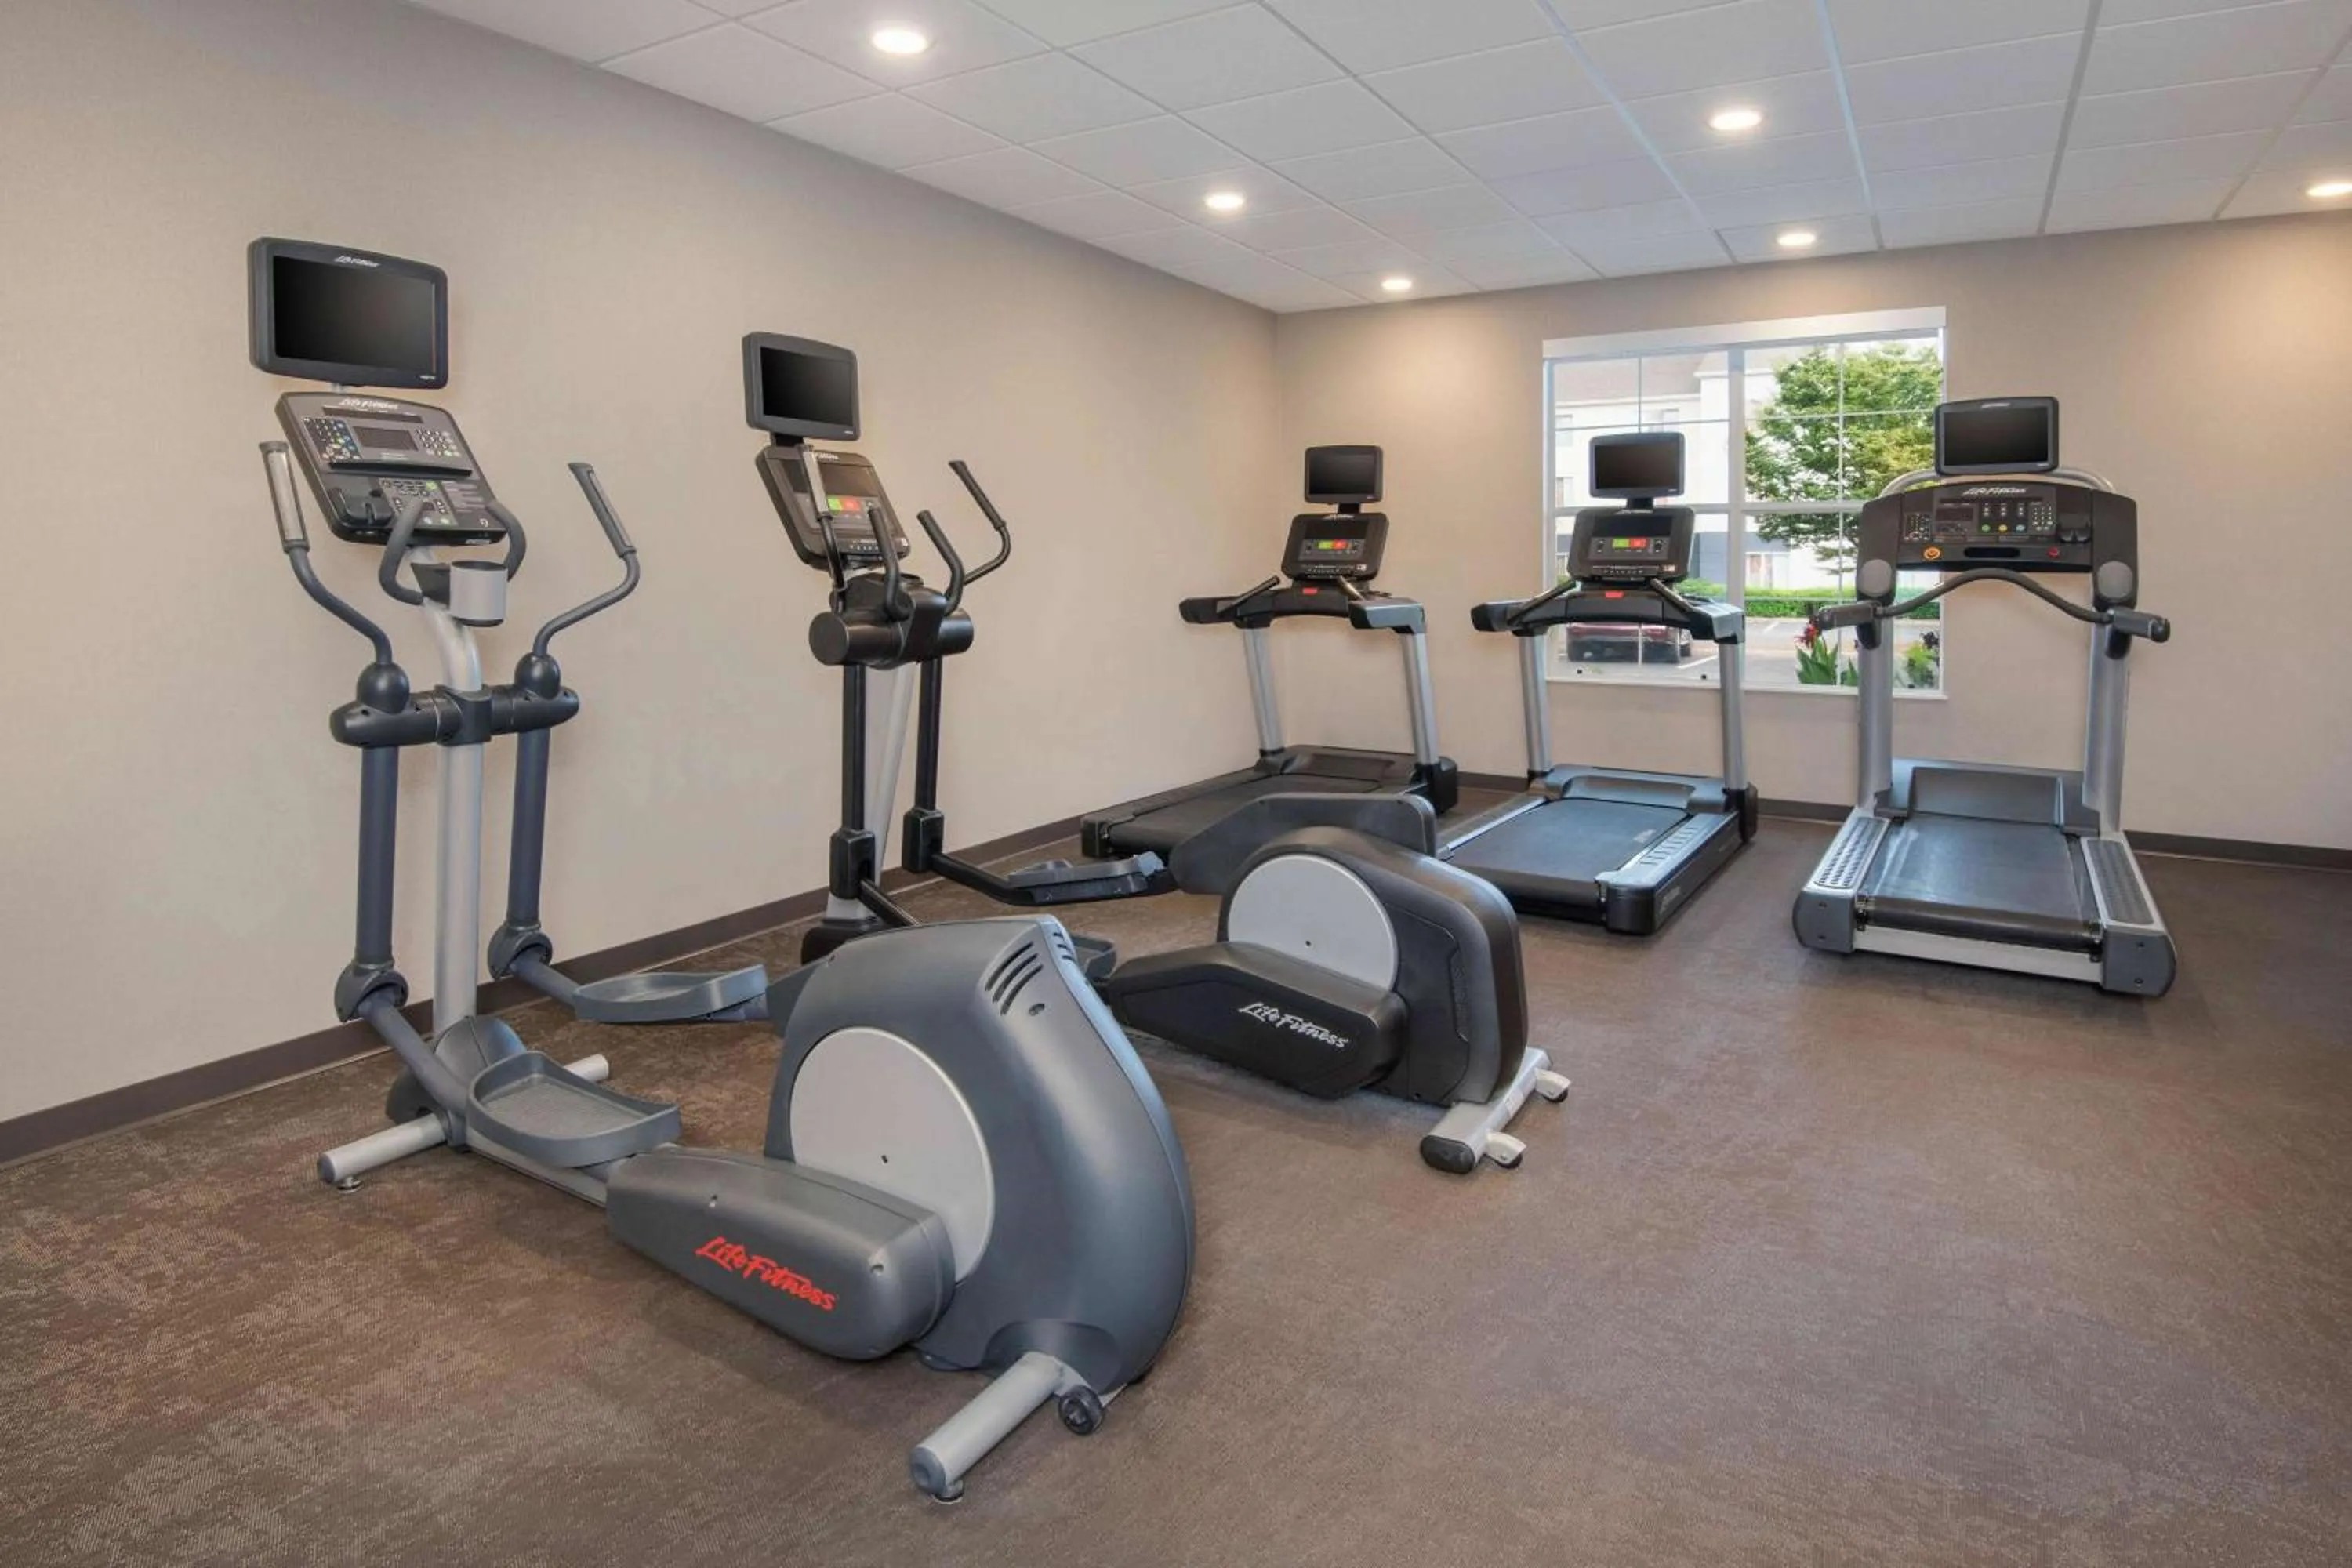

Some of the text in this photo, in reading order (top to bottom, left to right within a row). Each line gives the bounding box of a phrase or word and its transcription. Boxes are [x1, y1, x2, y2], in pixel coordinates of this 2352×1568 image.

[1238, 1002, 1349, 1048] Life Fitness
[695, 1236, 837, 1310] Life Fitness
